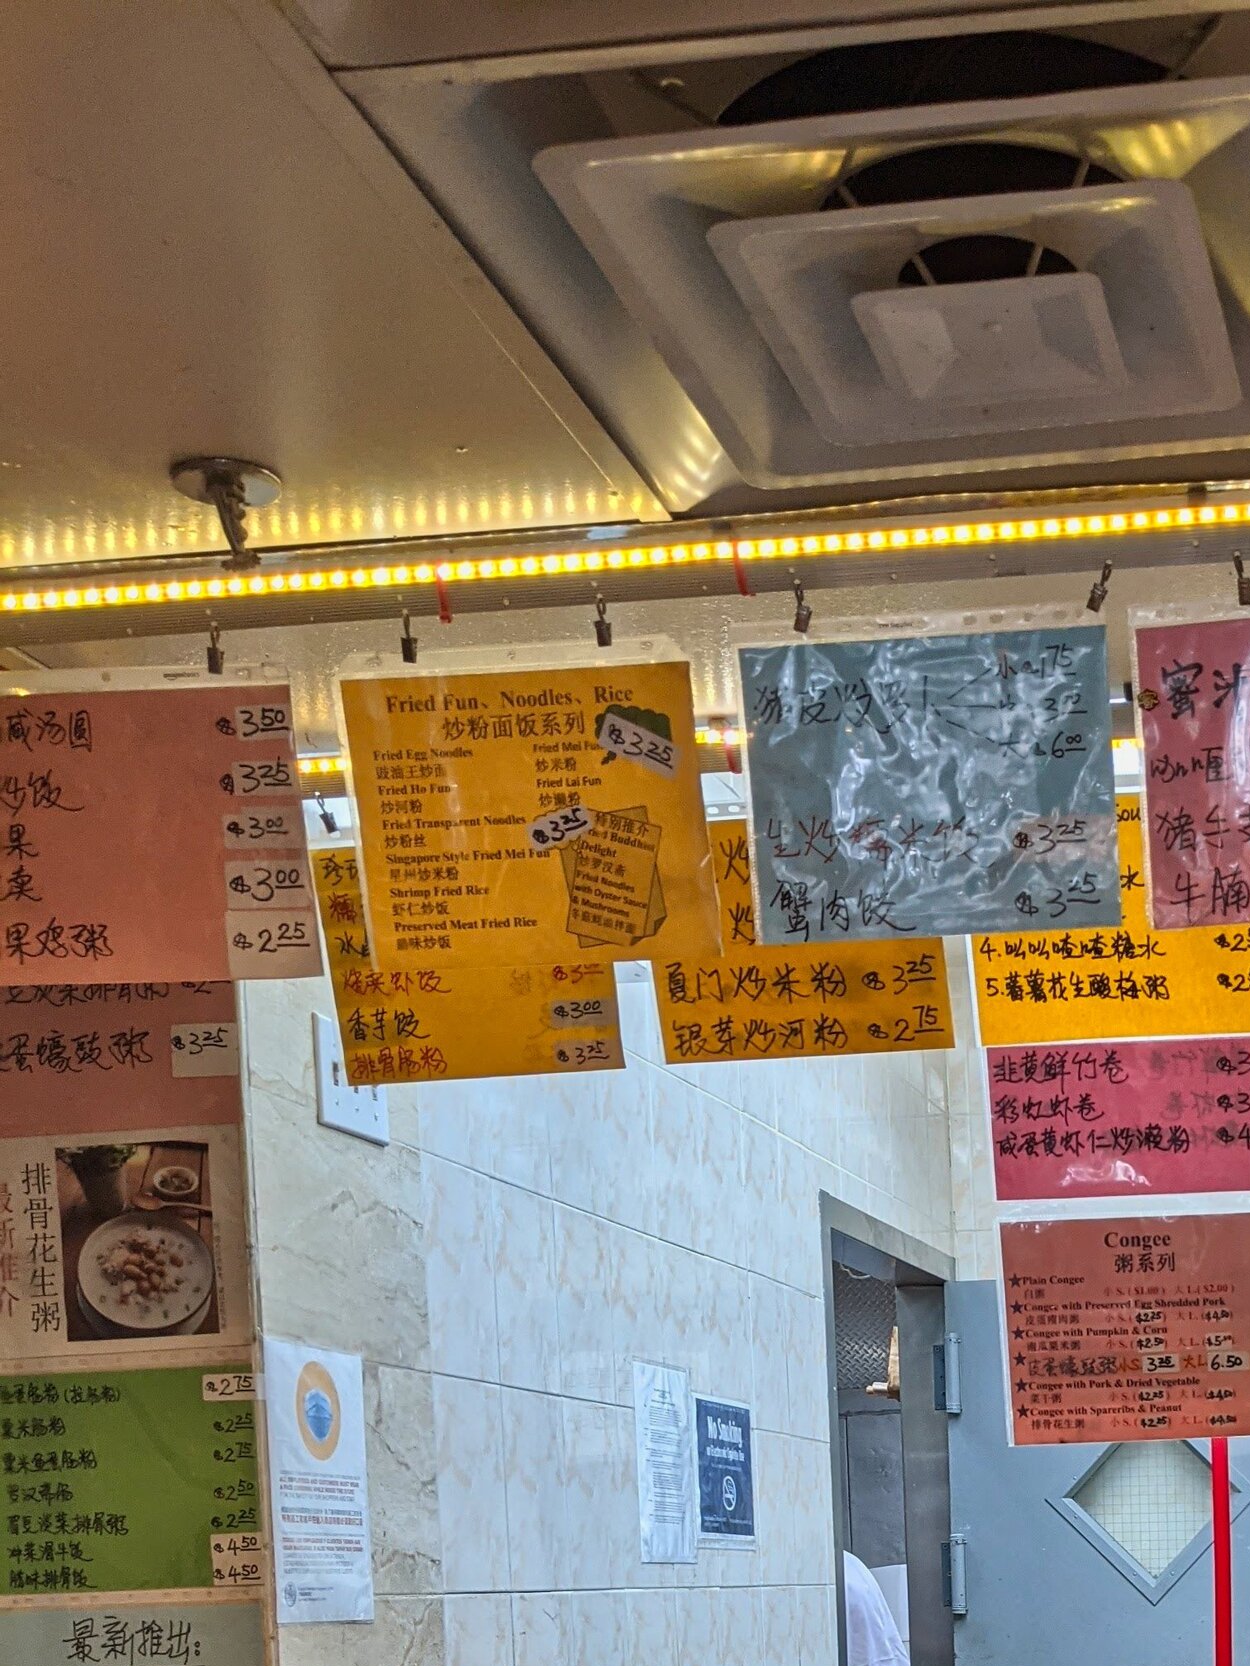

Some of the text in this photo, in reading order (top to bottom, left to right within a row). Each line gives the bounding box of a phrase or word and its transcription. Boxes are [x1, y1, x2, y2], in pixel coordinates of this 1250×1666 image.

[386, 694, 436, 714] Fried
[593, 685, 634, 705] Rice
[441, 710, 586, 742] 炒粉面饭系列
[373, 746, 474, 762] Fried Egg Noodles
[535, 757, 577, 773] 炒米粉
[378, 782, 451, 797] Fried Ho Fun
[536, 776, 603, 789] Fried Lai Fun
[384, 833, 427, 848] 炒粉丝
[386, 852, 441, 866] Singapore
[473, 849, 502, 861] Fried
[505, 849, 526, 859] Mei
[529, 848, 551, 859] Fun
[581, 840, 618, 858] Delight
[390, 885, 490, 899] Shrimp Fried Rice
[394, 916, 538, 932] Preserved Meat Fried Rice
[20, 1161, 61, 1334] 排骨花生粥
[1104, 1231, 1171, 1252] Congee
[1113, 1252, 1176, 1274] 粥系列
[1022, 1275, 1085, 1286] Plain Congee
[1024, 1296, 1226, 1312] Congee with Preserved Egg Shredded Pork
[1211, 1353, 1243, 1371] 6.50
[1028, 1380, 1064, 1391] Congee
[1065, 1378, 1086, 1389] with
[1088, 1377, 1112, 1388] Pork
[1126, 1376, 1152, 1387] Dried
[1154, 1375, 1201, 1388] Vegetable
